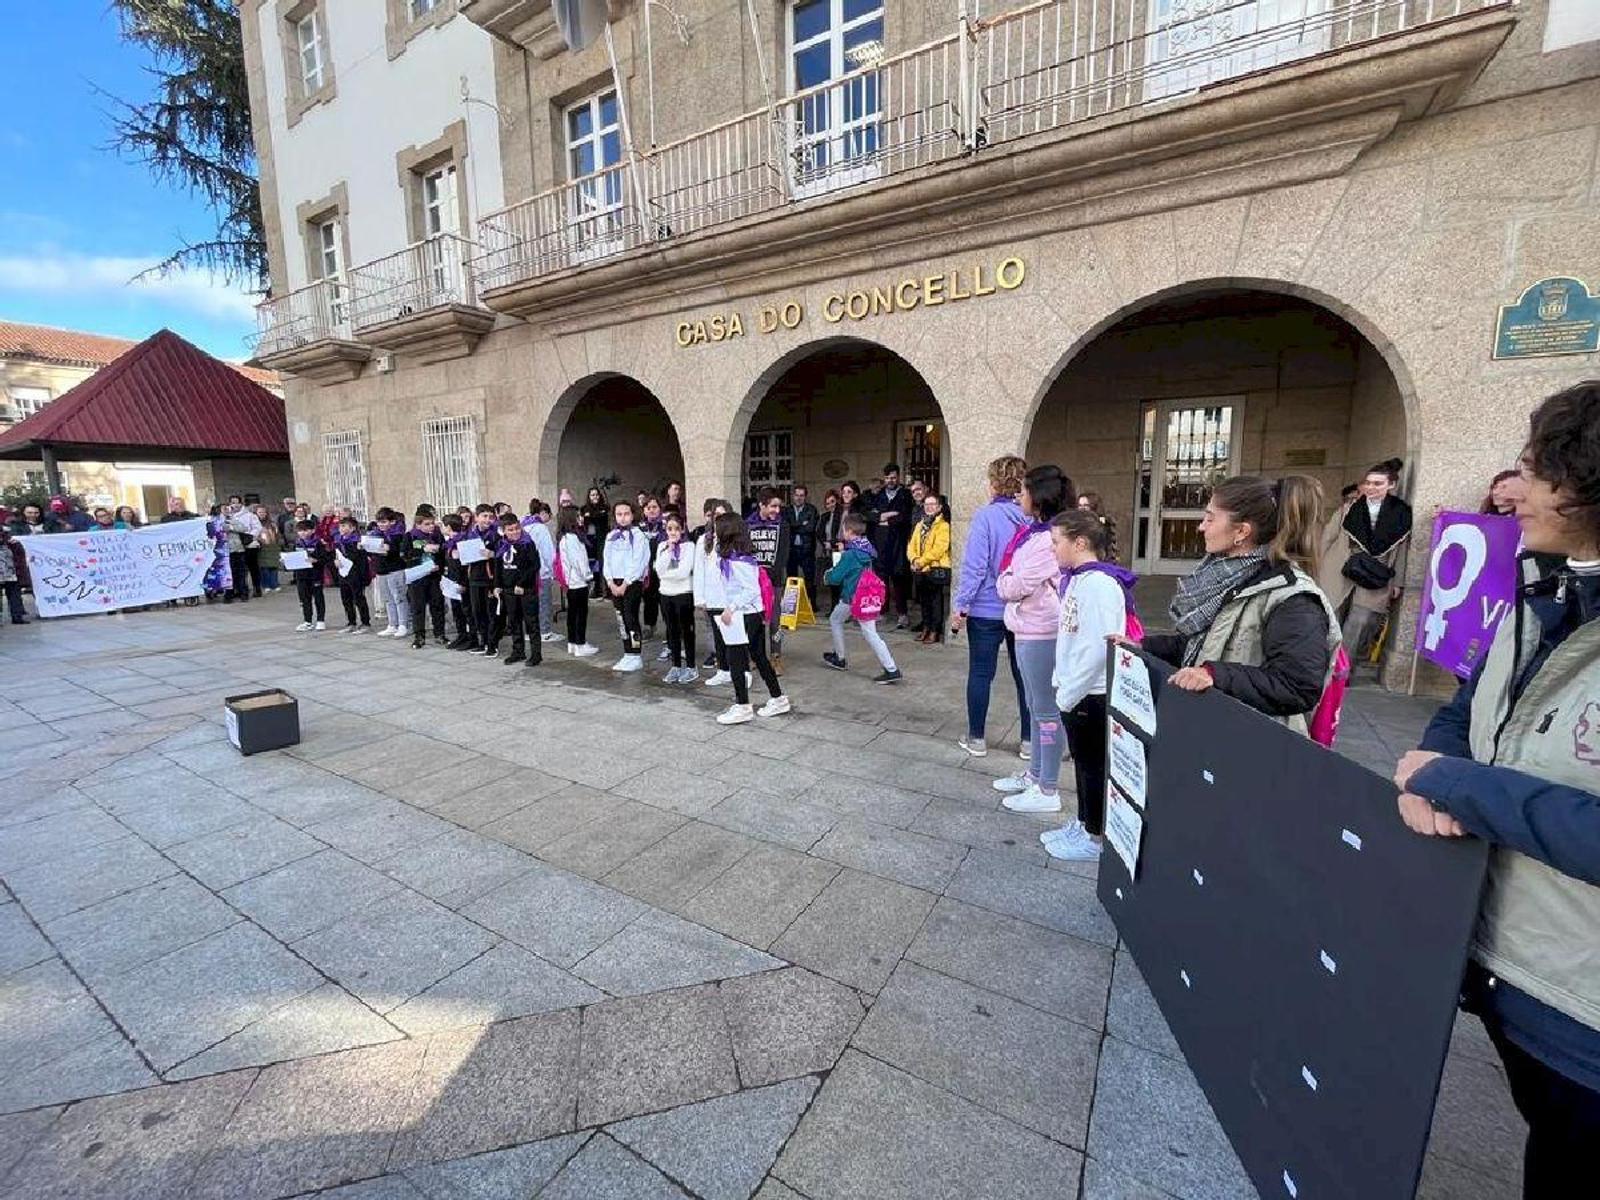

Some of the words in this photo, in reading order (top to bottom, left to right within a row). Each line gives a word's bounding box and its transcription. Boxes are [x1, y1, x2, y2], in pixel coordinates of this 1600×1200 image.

[676, 313, 744, 347] CASA
[758, 302, 803, 334] DO
[823, 255, 1026, 323] CONCELLO
